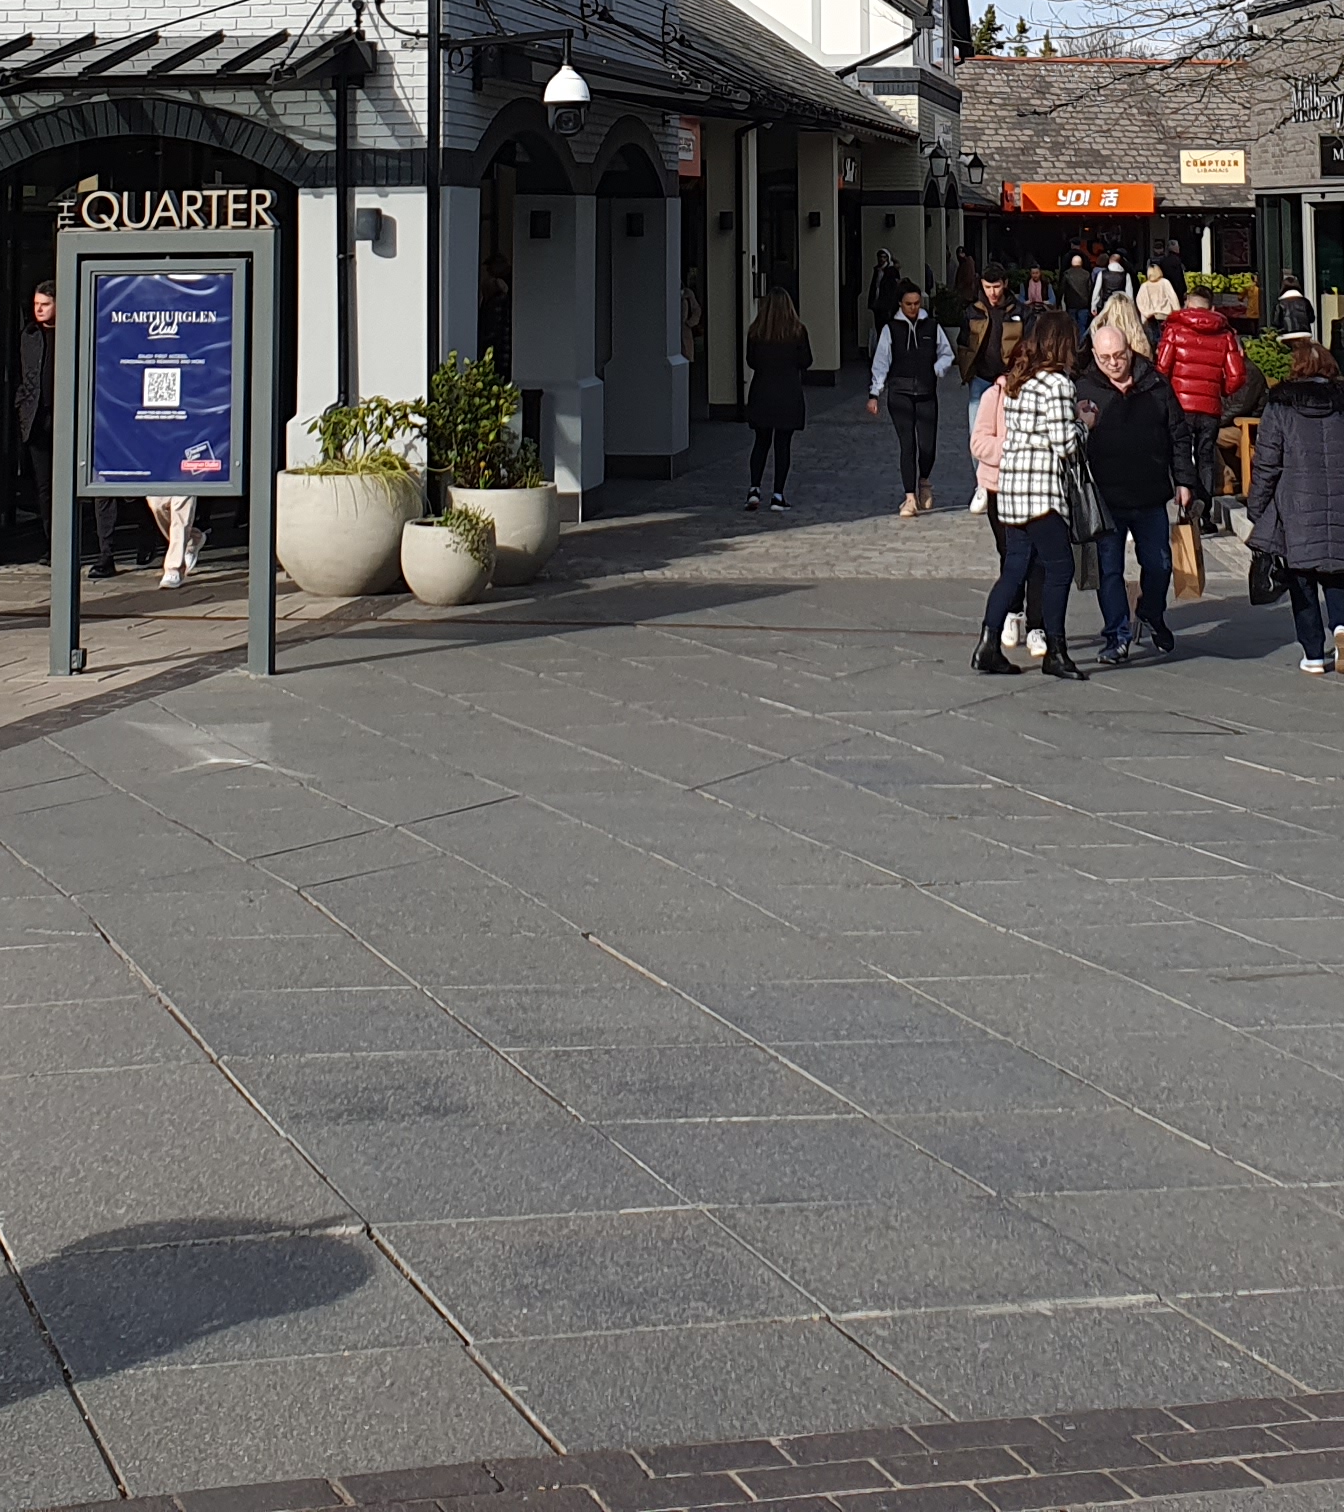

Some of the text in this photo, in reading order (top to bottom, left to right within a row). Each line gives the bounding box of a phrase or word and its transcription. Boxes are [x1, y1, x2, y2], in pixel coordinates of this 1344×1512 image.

[1186, 159, 1239, 168] COMPTOIR
[1057, 189, 1091, 206] YO!
[1099, 188, 1119, 207] 活
[82, 189, 276, 231] QUARTER
[148, 311, 179, 336] Club
